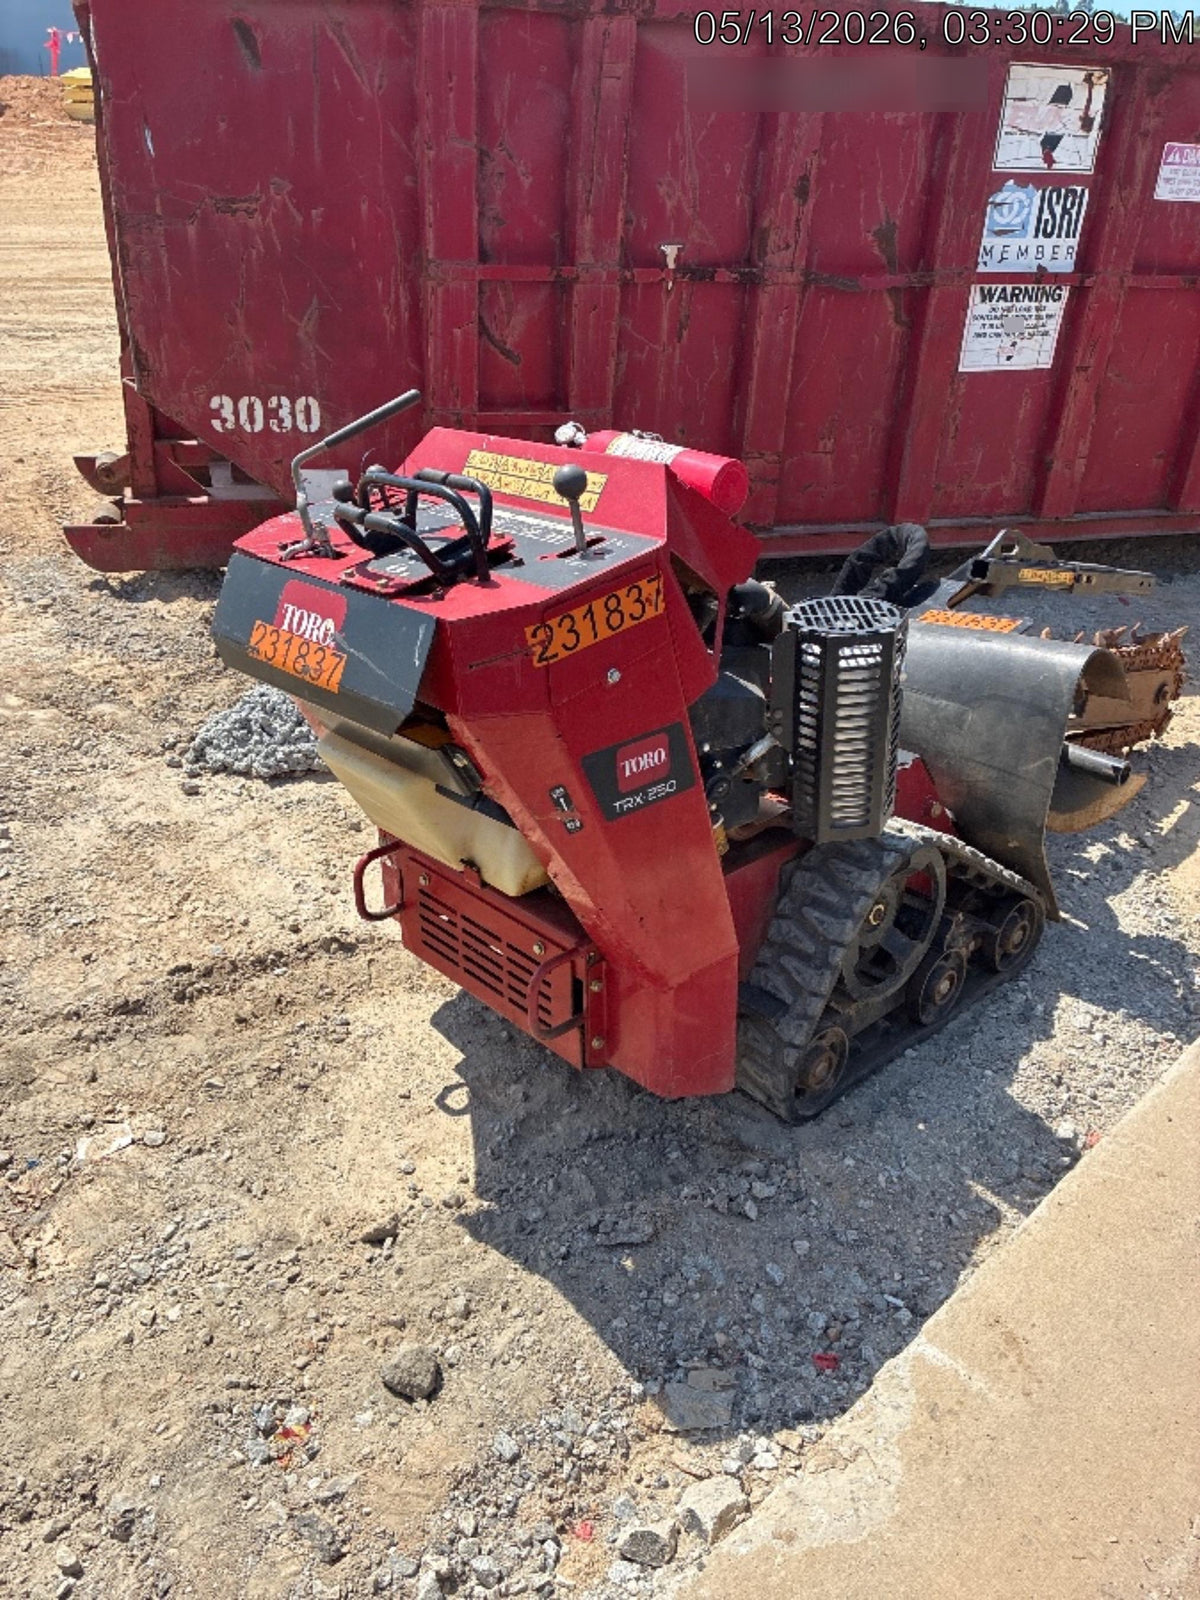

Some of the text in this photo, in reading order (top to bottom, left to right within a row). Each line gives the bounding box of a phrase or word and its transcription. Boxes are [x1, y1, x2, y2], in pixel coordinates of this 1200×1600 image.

[1033, 187, 1086, 239] ISRI
[981, 245, 1075, 261] MEMBER
[979, 286, 1063, 303] WARNING
[209, 395, 320, 432] 3030
[281, 603, 336, 646] TORO
[530, 573, 661, 664] 231837
[247, 622, 344, 687] 231837
[620, 748, 667, 778] TORO
